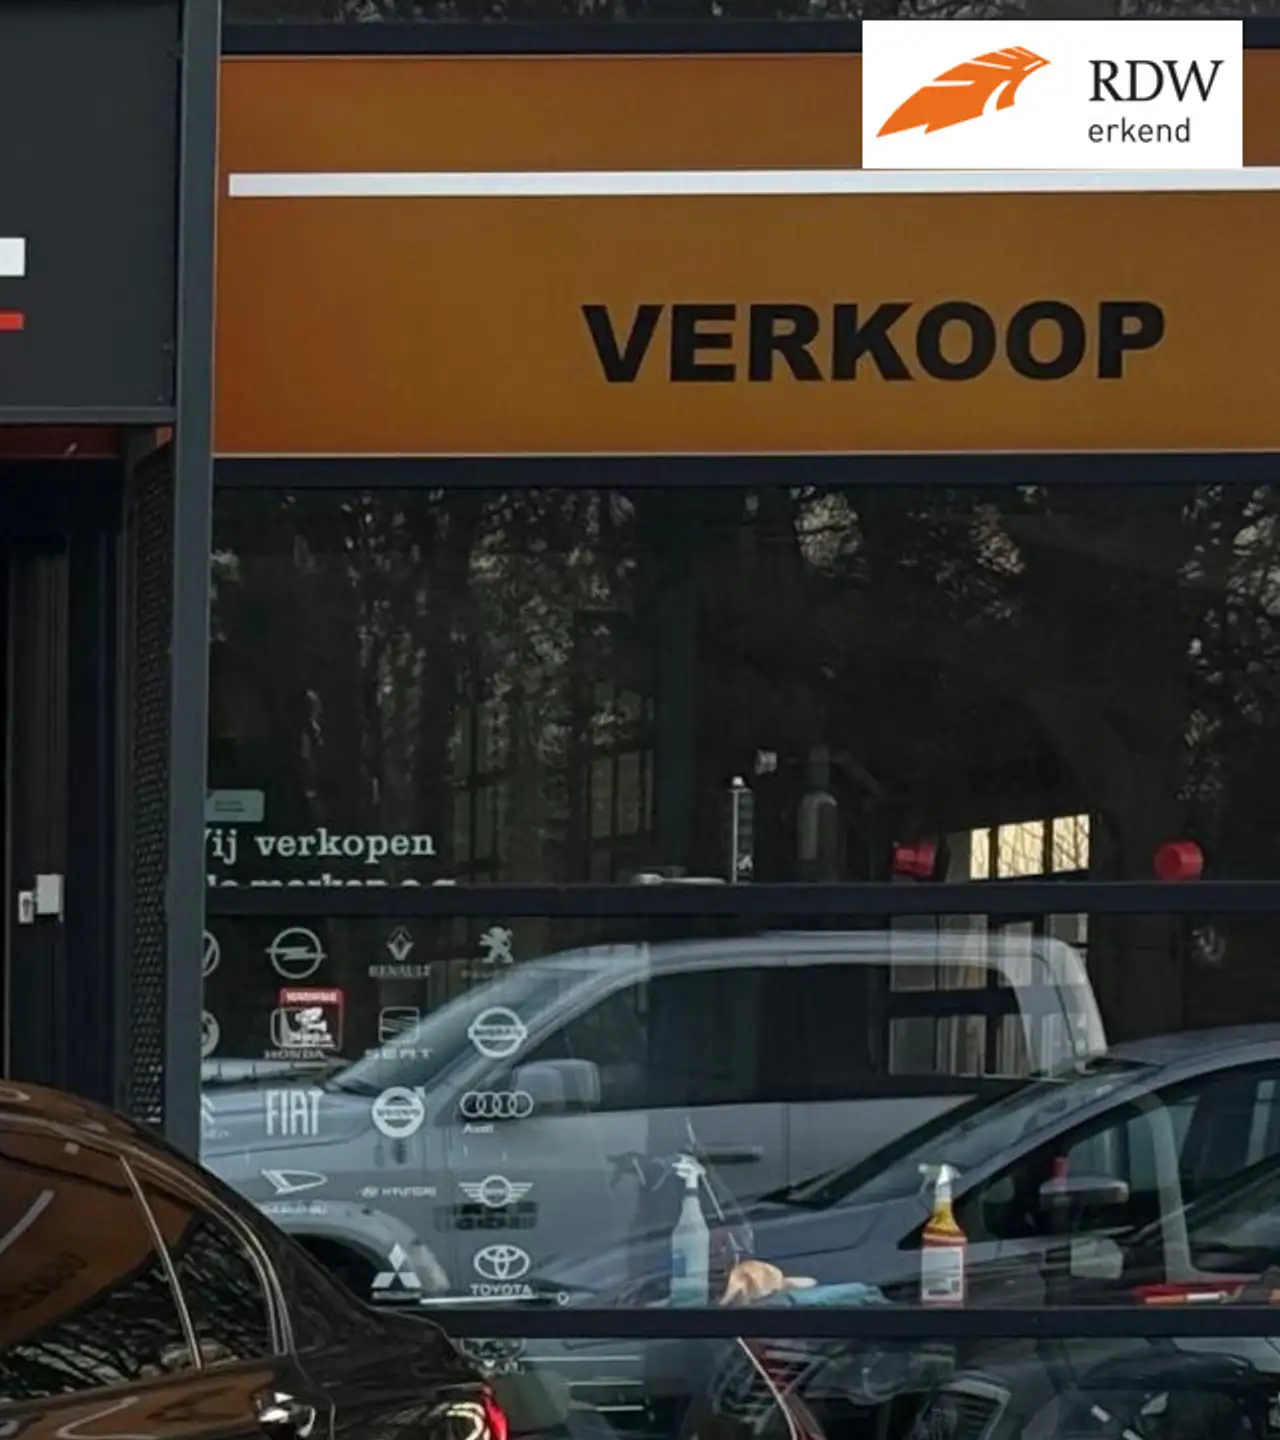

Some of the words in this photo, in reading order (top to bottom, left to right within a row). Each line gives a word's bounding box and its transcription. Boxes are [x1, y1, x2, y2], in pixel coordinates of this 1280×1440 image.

[581, 300, 1165, 384] VERKOOP
[255, 828, 436, 865] verkopen
[265, 1088, 325, 1136] FIAT
[469, 1283, 533, 1298] TOYOTA
